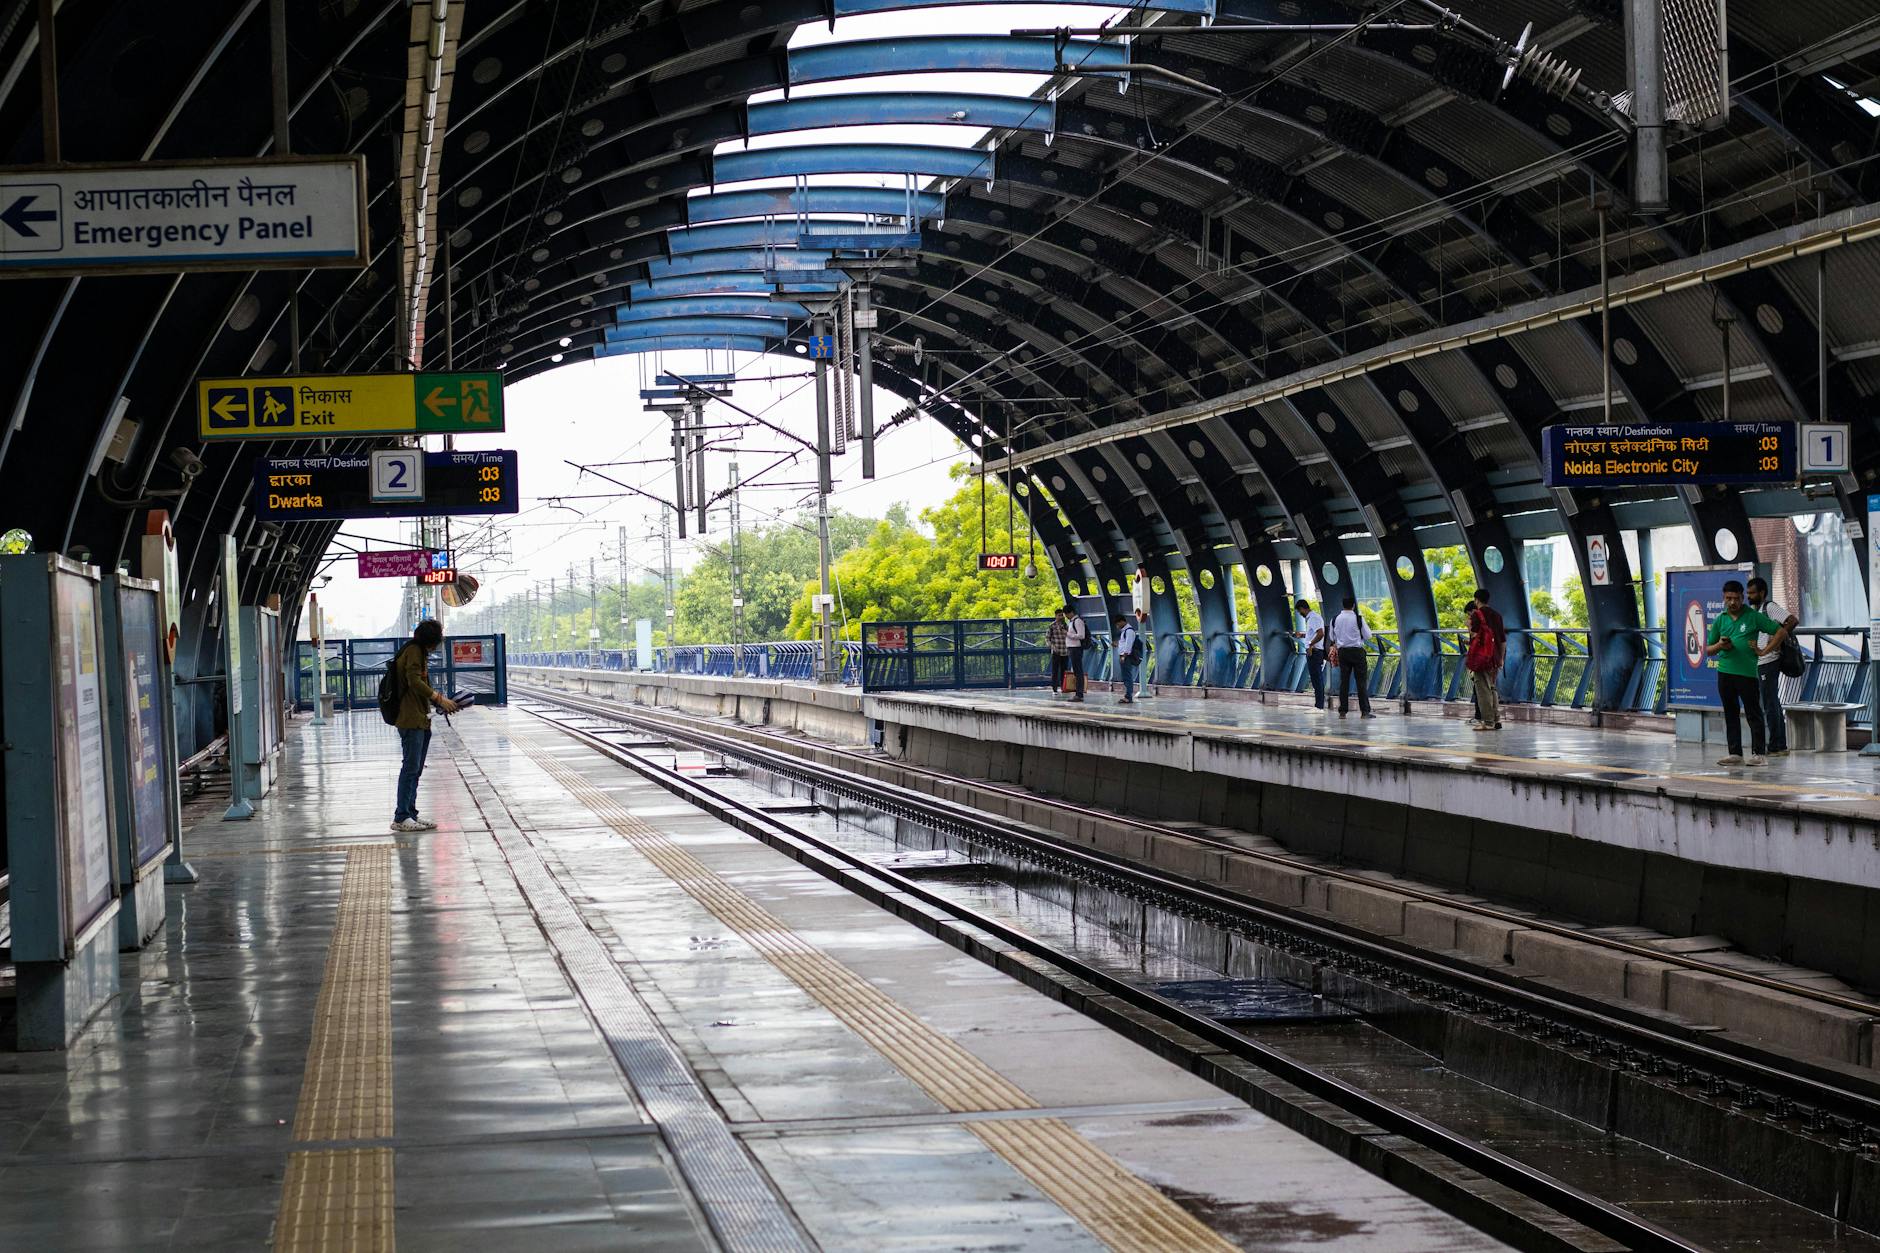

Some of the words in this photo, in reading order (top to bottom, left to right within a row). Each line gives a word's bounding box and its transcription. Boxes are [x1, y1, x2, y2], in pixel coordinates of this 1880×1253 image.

[74, 179, 230, 211] आपातकालीन
[237, 176, 297, 206] पैनल
[74, 221, 229, 248] Emergency
[238, 215, 313, 239] Panel
[816, 346, 828, 358] 37
[299, 386, 352, 405] निकास
[301, 411, 335, 425] Exit
[1564, 440, 1606, 456] नोएडा
[1681, 437, 1709, 451] सिटी
[1759, 436, 1778, 451] :03
[1821, 435, 1832, 462] 1
[1564, 460, 1601, 475] Noida
[1605, 459, 1668, 474] Electronic
[1672, 459, 1699, 475] City
[1759, 456, 1778, 470] :03
[268, 474, 312, 487] द्वारका
[387, 460, 407, 488] 2
[478, 466, 500, 481] :03
[269, 493, 323, 509] Dwarka
[479, 487, 500, 502] :03
[986, 556, 1015, 568] 10:07
[425, 570, 453, 583] 10:07
